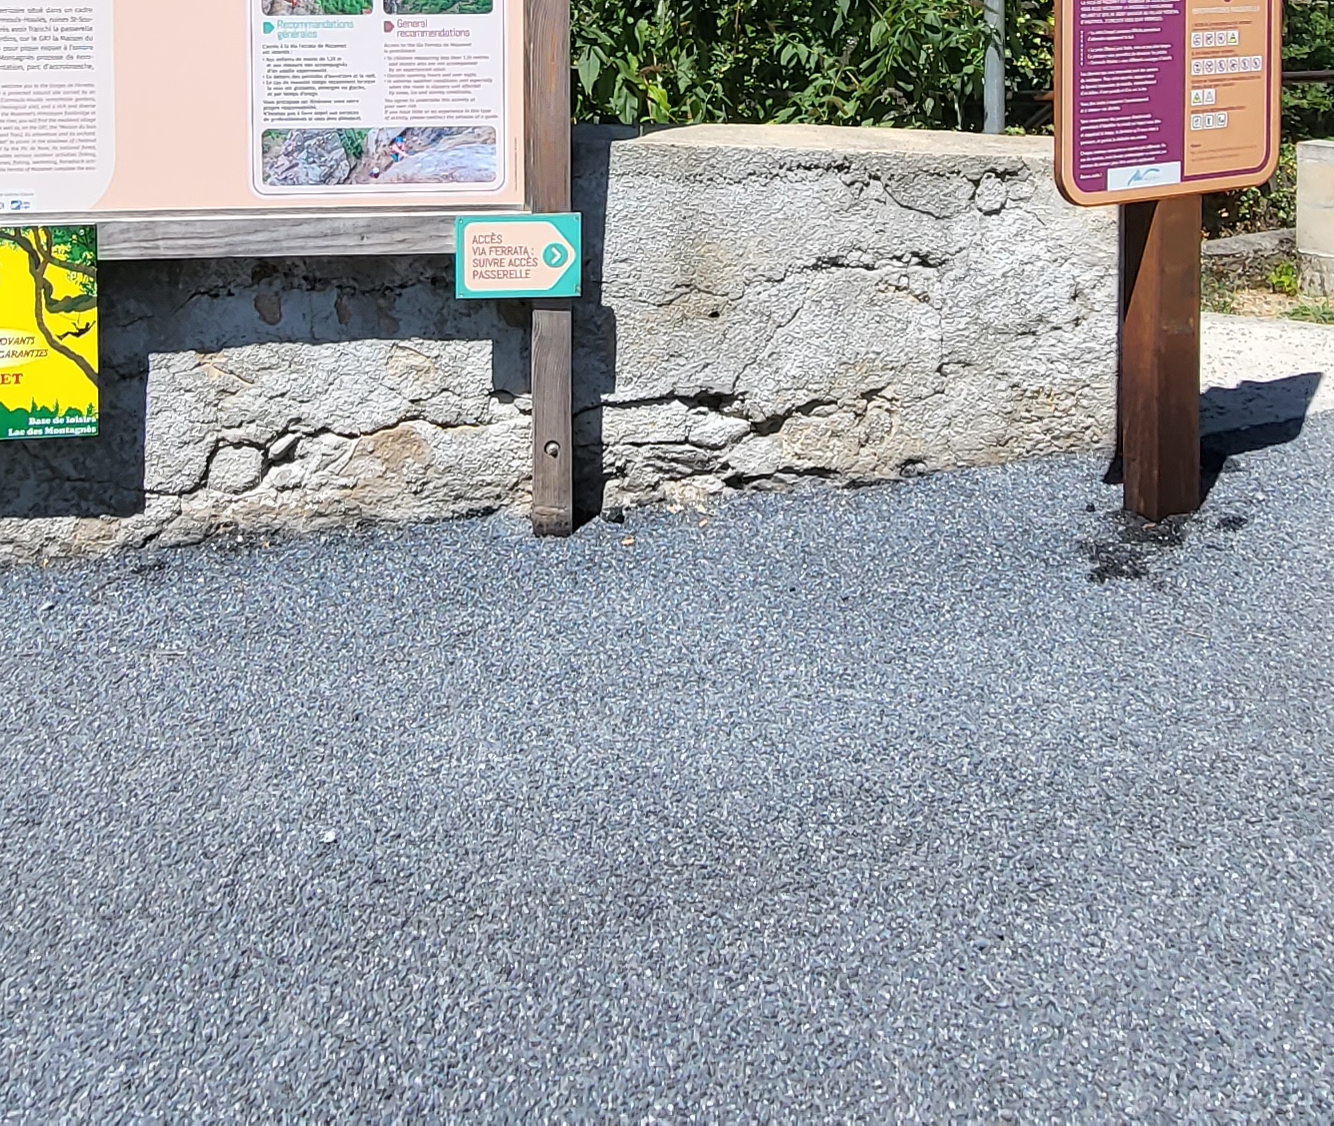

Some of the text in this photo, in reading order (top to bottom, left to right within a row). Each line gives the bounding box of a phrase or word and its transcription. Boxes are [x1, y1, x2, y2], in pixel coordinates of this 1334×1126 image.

[397, 19, 427, 29] General
[472, 232, 503, 245] ACCÈS
[472, 246, 529, 256] VIA FERRATA
[472, 255, 538, 268] SUIVRE ACCÈS
[473, 269, 531, 280] PASSERELLE
[28, 415, 97, 425] Base de loisirs
[27, 427, 43, 435] des
[45, 425, 97, 435] Montagnès
